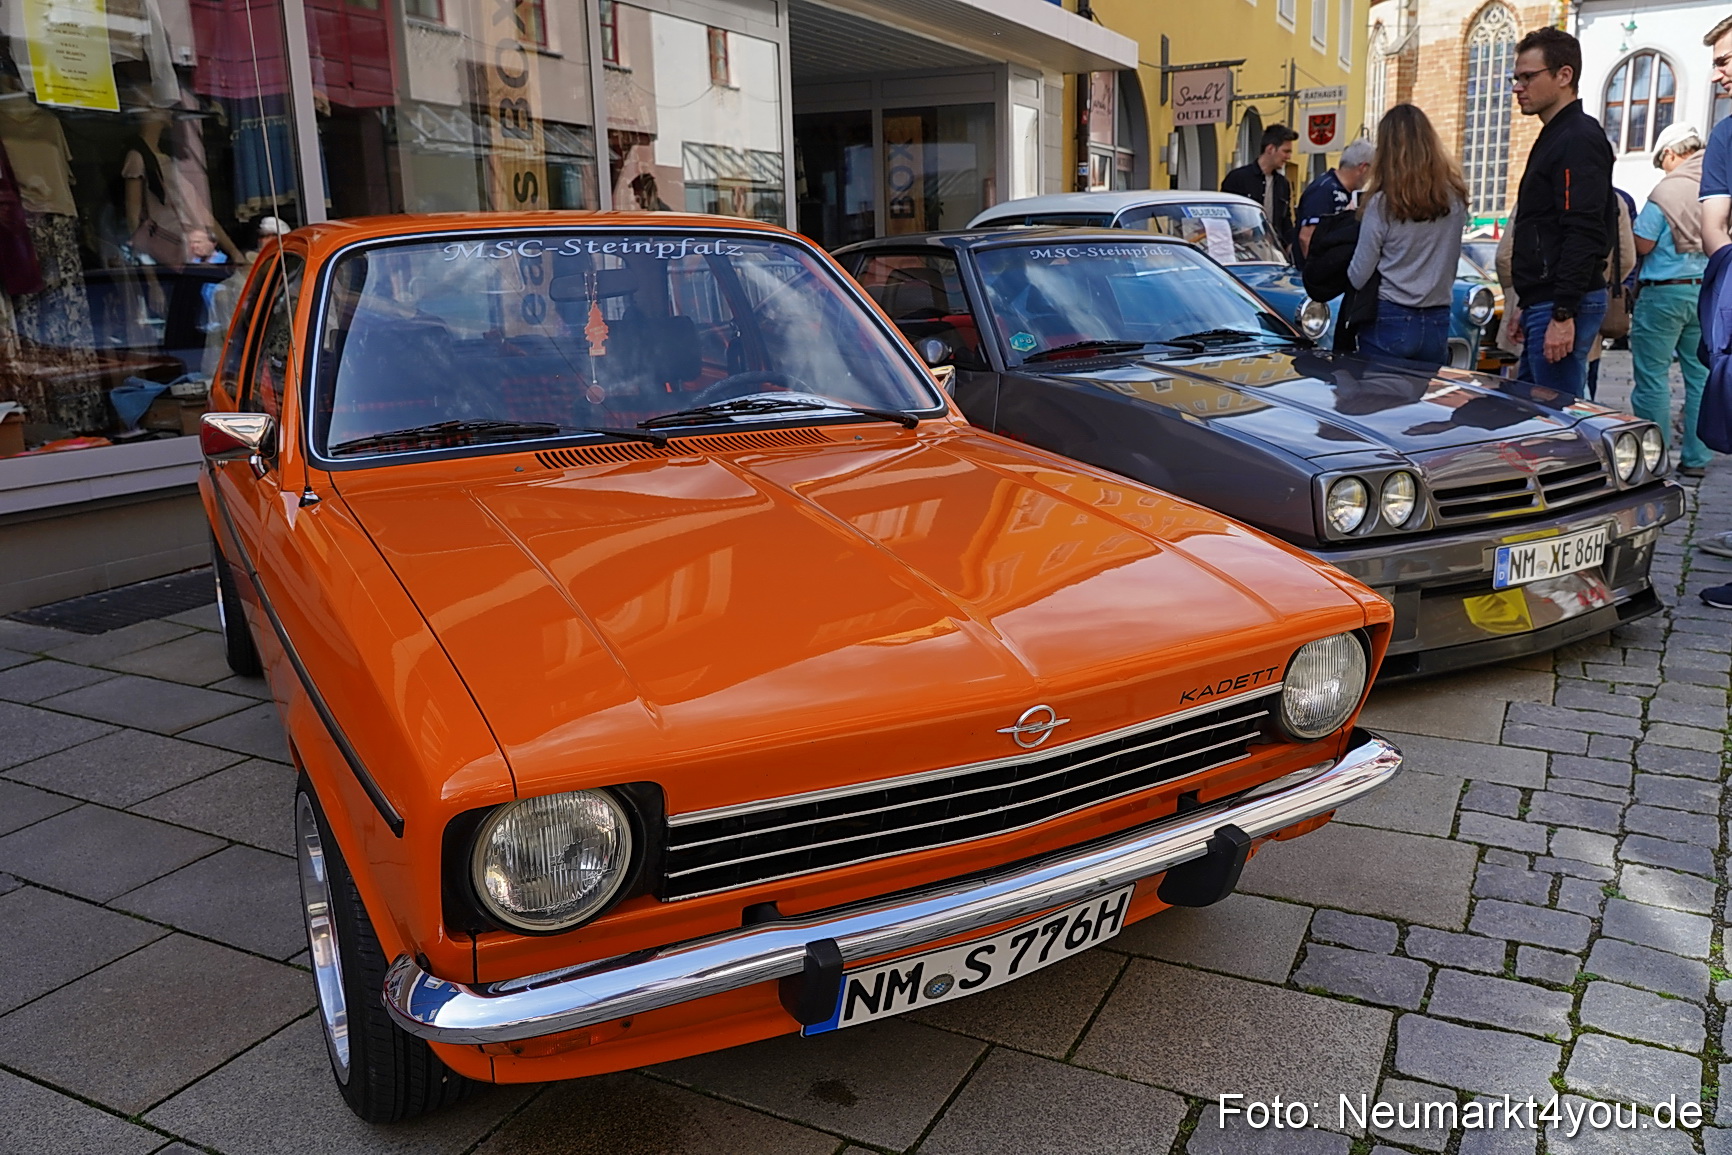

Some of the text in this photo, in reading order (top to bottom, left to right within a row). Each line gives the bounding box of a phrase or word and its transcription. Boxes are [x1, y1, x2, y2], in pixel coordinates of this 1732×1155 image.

[492, 0, 533, 140] BOX
[1177, 109, 1222, 121] OUTLET
[887, 138, 915, 219] BOX
[443, 237, 745, 262] MSC-Steinpfalz
[1029, 245, 1173, 260] MSC-Steinpfalz
[1509, 532, 1605, 581] NM XE 86H
[1179, 665, 1280, 705] KADETT
[843, 891, 1129, 1021] NM S 776H
